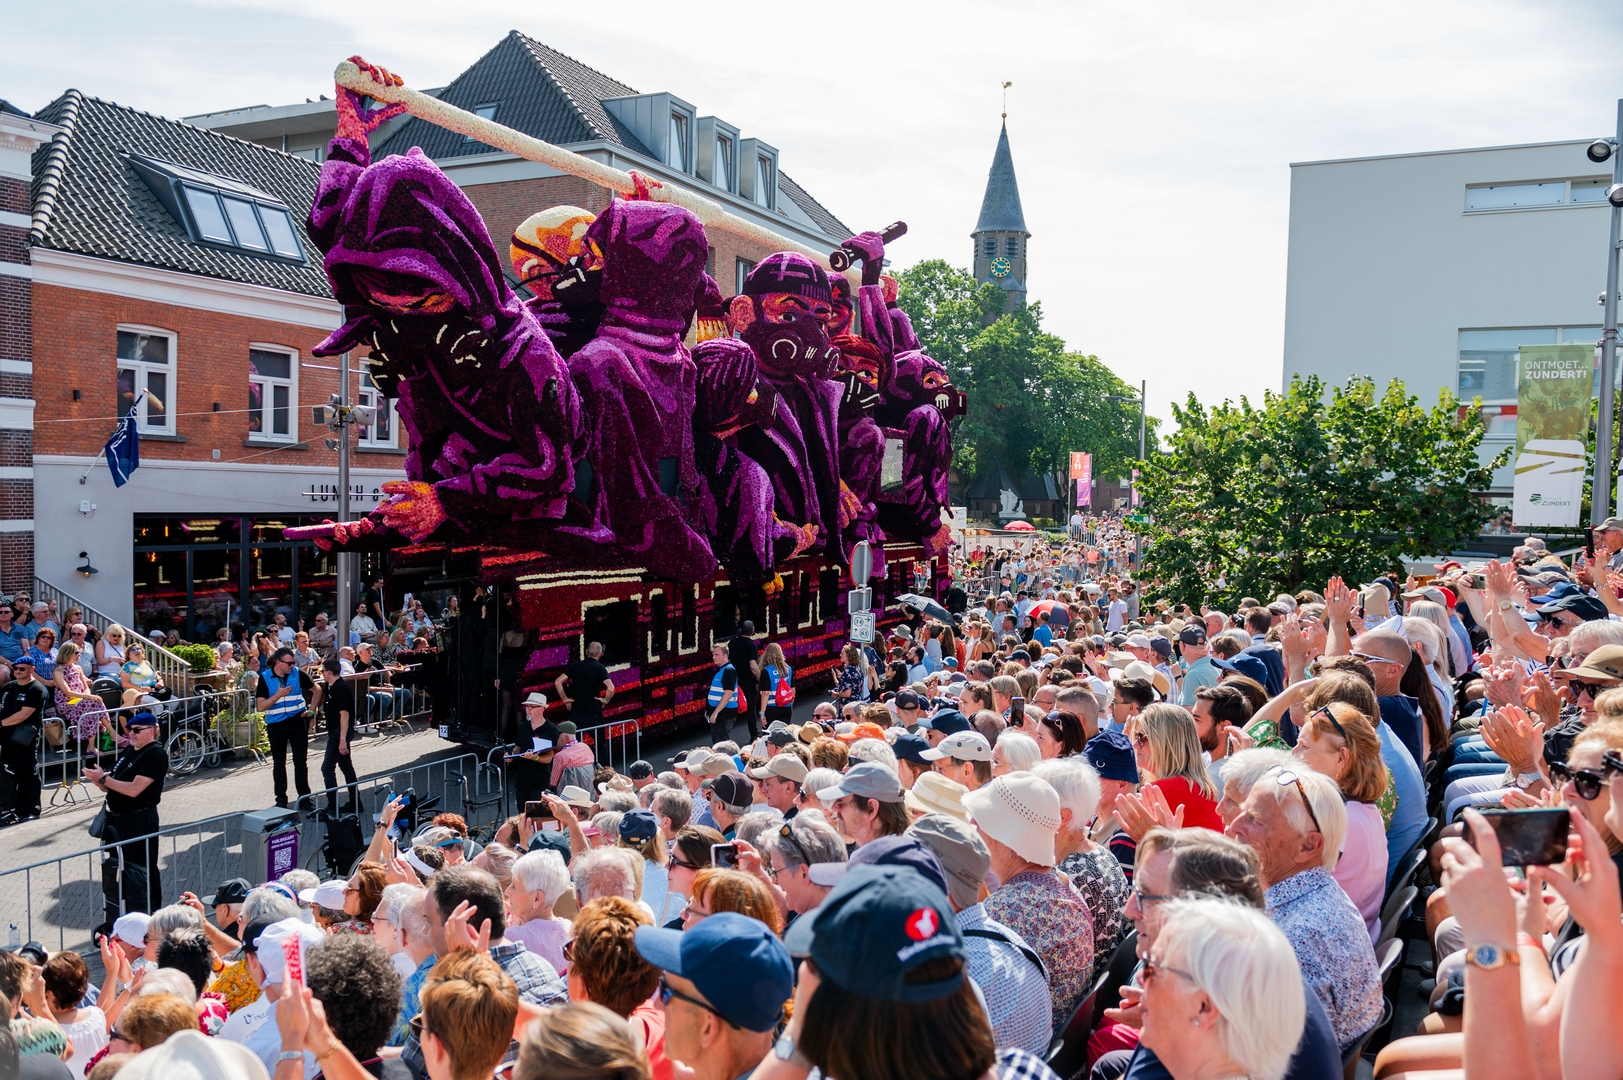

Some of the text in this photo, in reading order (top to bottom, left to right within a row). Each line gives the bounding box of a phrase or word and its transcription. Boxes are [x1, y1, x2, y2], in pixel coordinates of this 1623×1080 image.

[1524, 360, 1588, 370] ONTMOET...
[1525, 370, 1587, 379] ZUNDERT!
[311, 484, 364, 502] LUNH
[440, 726, 448, 734] 12
